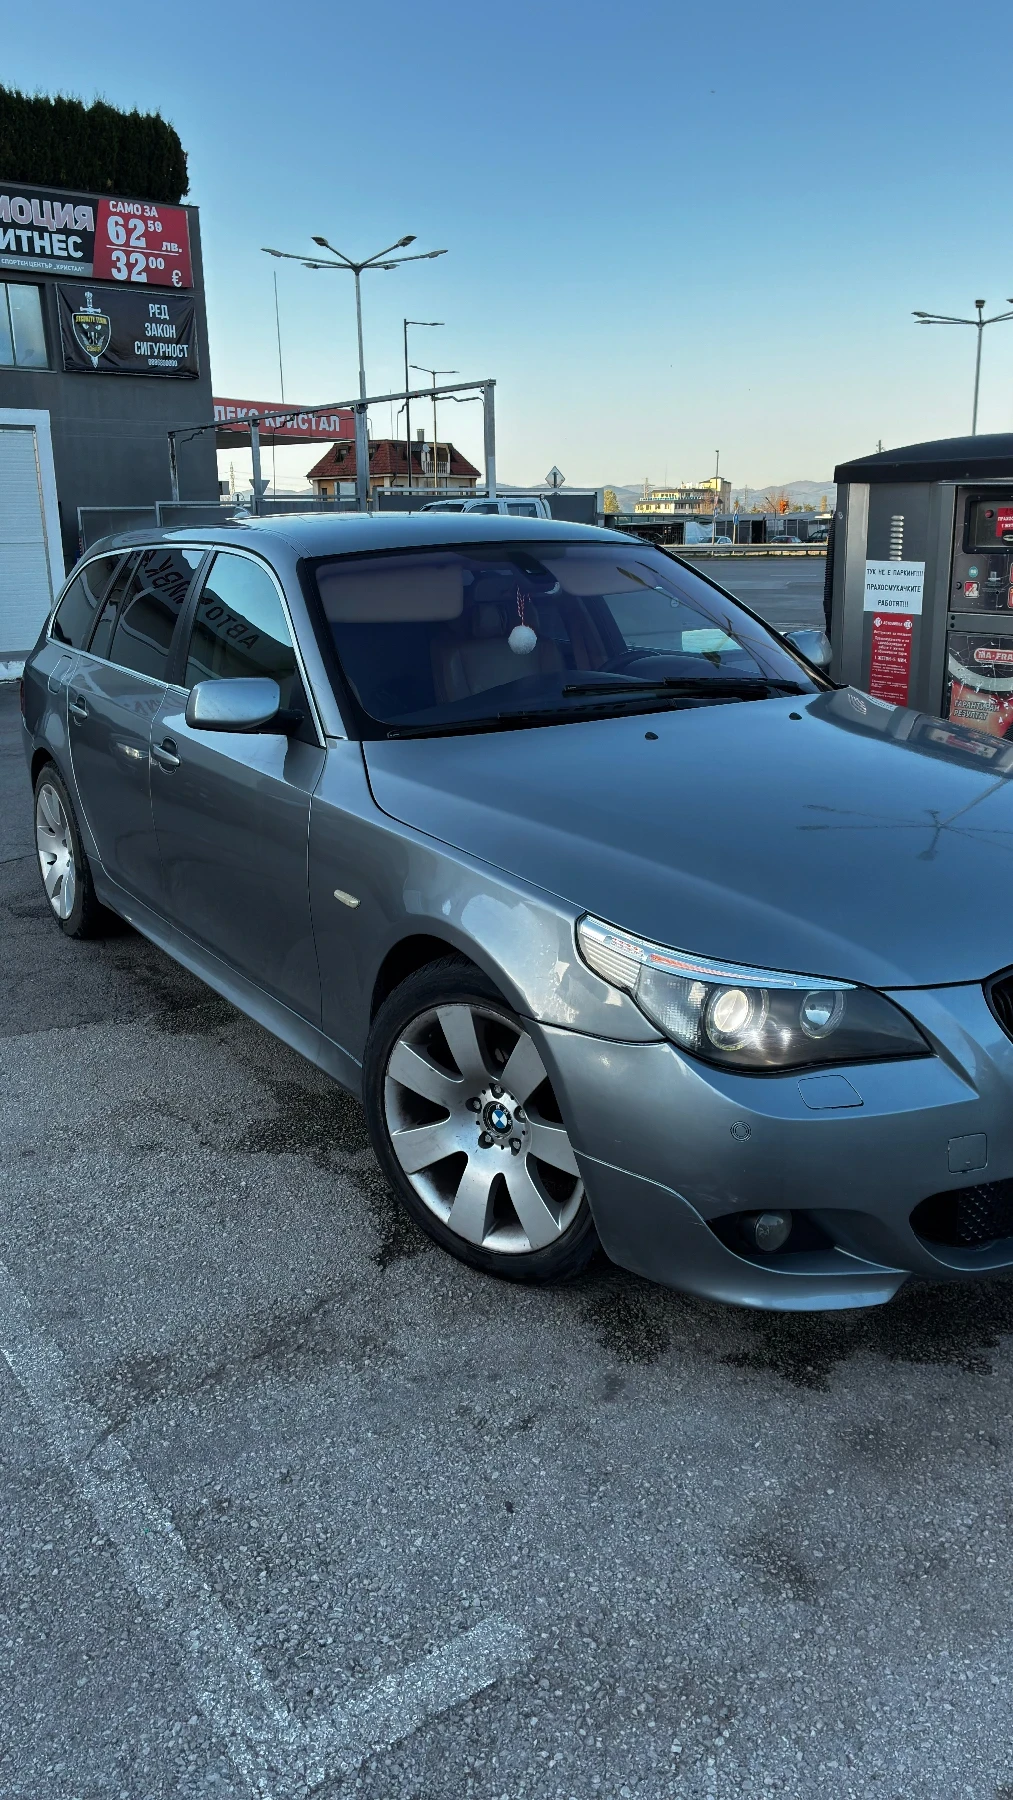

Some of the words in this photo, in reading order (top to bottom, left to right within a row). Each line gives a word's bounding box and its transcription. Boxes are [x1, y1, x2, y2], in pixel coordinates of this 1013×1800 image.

[109, 200, 142, 216] САМО
[144, 205, 159, 218] ЗА
[107, 215, 147, 248] 62
[147, 220, 163, 233] 59
[111, 250, 148, 283] 32
[148, 256, 165, 270] 00
[171, 270, 182, 287] €
[148, 303, 170, 320] РЕД
[144, 322, 177, 339] ЗАКОН
[134, 340, 189, 358] СИГУРНОСТ
[866, 583, 922, 593] ПРАХОСМУКАЧКИТЕ
